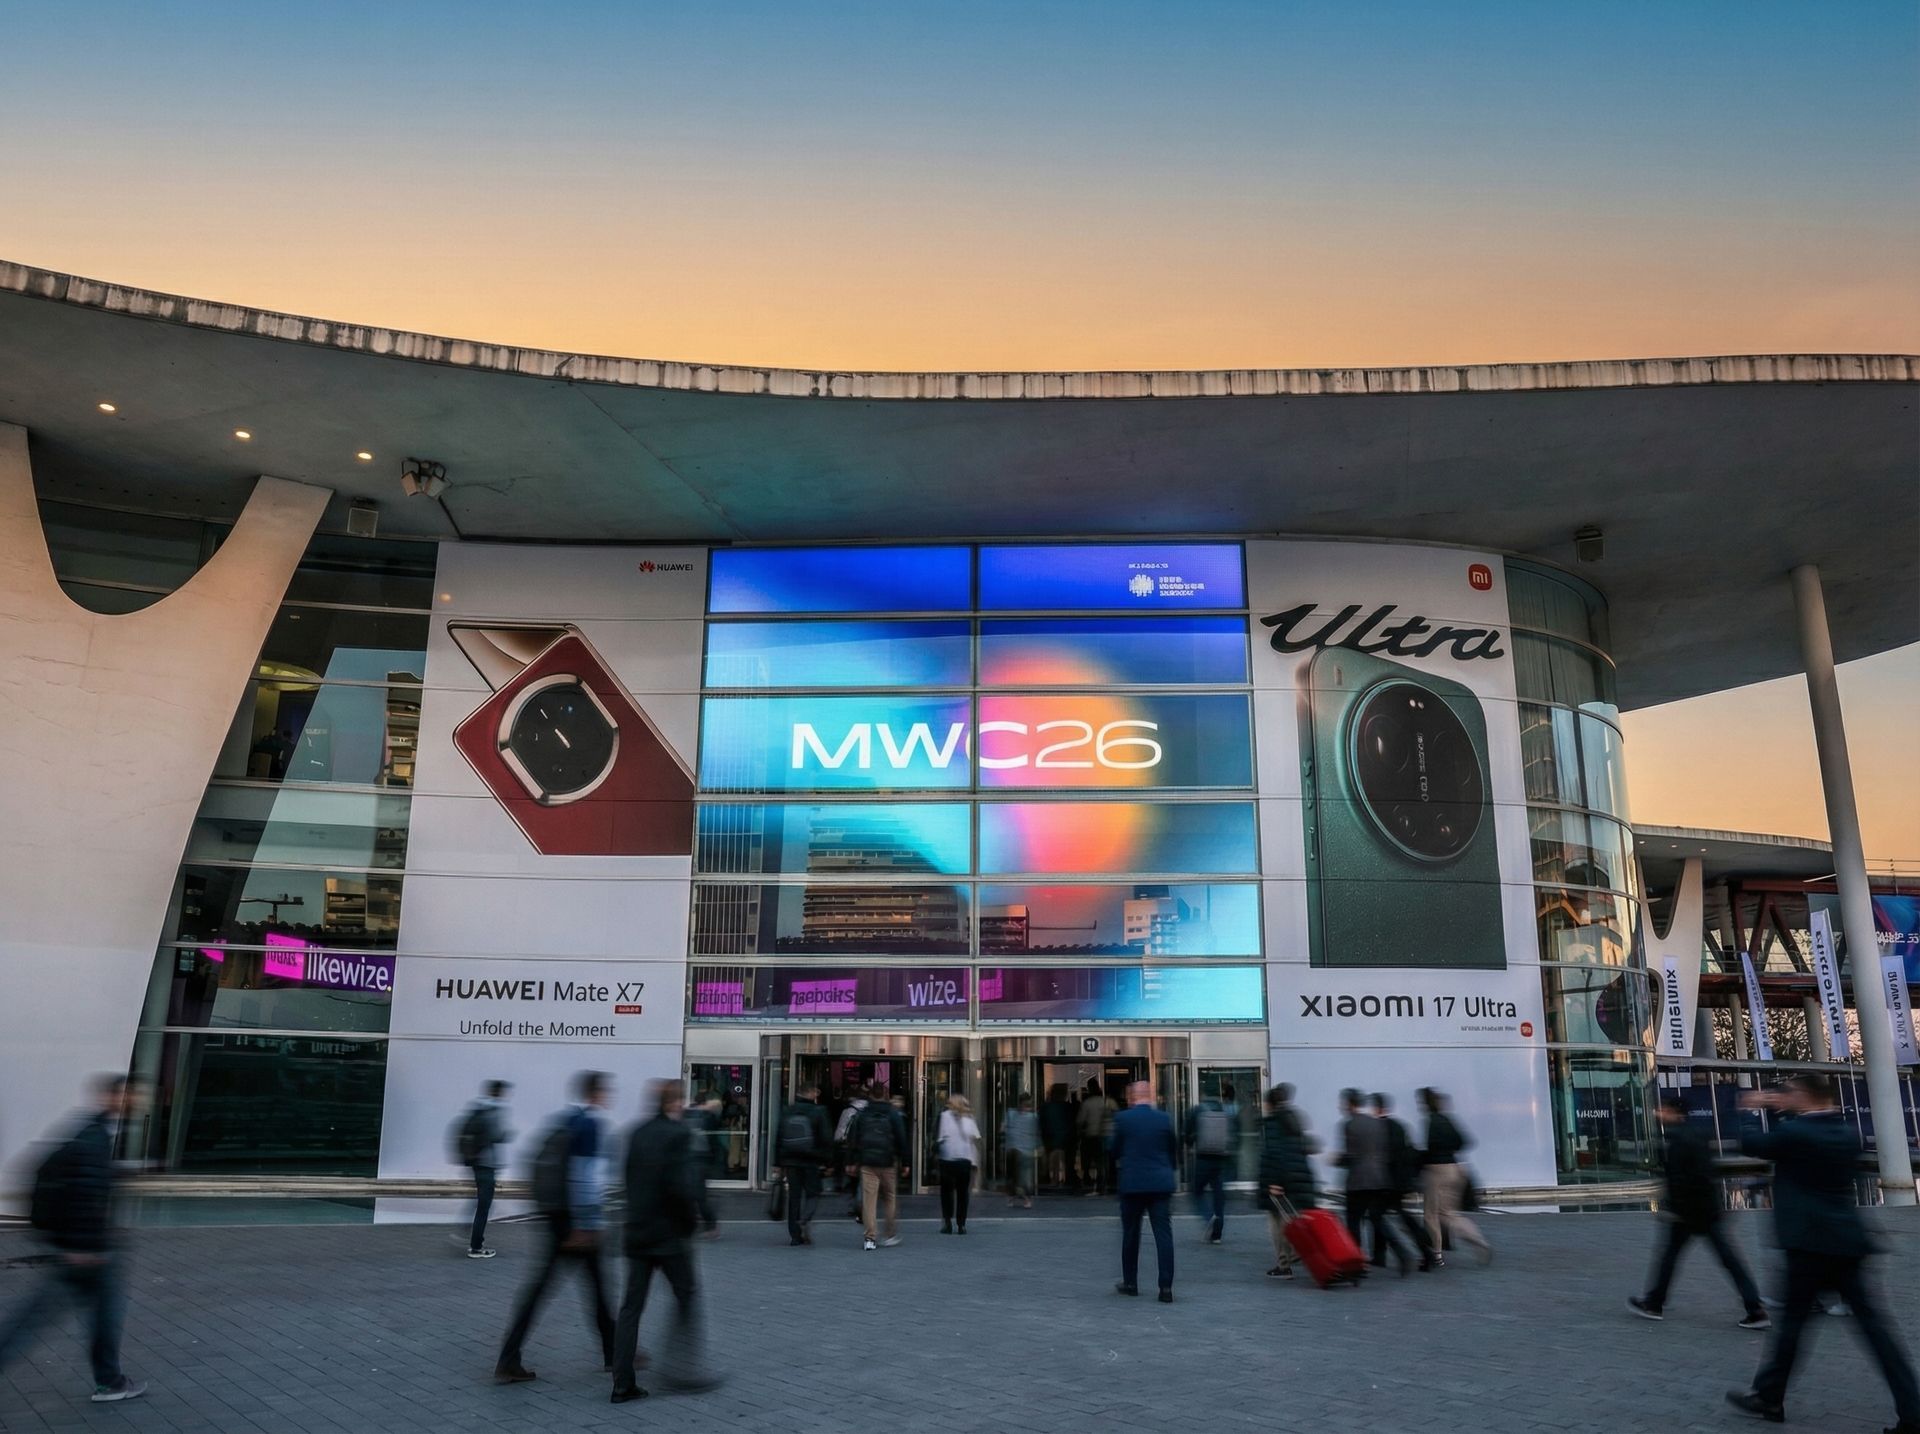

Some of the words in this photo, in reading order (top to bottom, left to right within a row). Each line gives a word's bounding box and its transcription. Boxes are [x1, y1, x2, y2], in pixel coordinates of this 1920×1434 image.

[657, 563, 693, 572] HUAWEI
[1260, 603, 1505, 660] Ultra
[791, 719, 1163, 769] MWC26
[435, 978, 545, 1001] HUAWEI
[553, 981, 609, 1002] Mate
[615, 982, 645, 1002] X7
[1299, 994, 1424, 1018] xiaomi
[1433, 996, 1456, 1018] 17
[1464, 996, 1518, 1018] Ultra
[460, 1019, 513, 1036] Unfold
[518, 1021, 545, 1036] the
[549, 1022, 616, 1037] Moment
